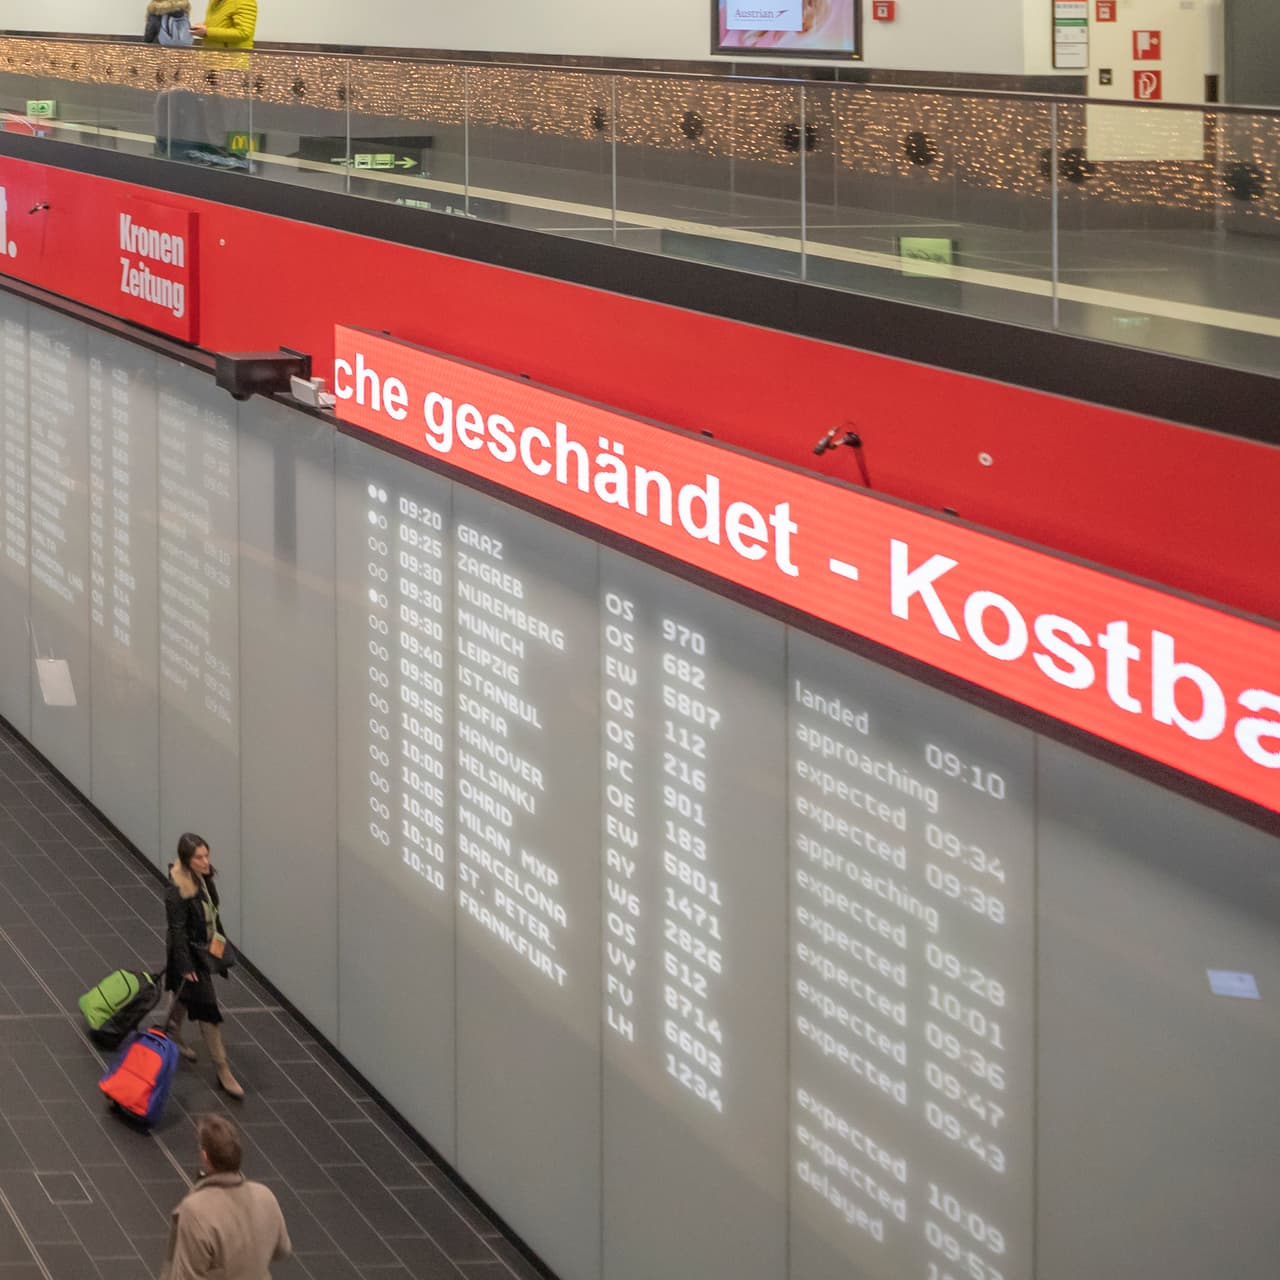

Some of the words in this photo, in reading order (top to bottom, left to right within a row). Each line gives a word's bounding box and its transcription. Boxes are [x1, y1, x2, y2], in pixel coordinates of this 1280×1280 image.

[736, 8, 775, 18] Austrian
[119, 211, 185, 268] Kronen
[120, 255, 186, 319] Zeitung
[334, 353, 408, 422] che
[423, 388, 800, 577] geschändet
[400, 497, 441, 530] 09:20
[458, 524, 502, 559] GRAZ
[606, 593, 633, 621] OS
[663, 619, 705, 655] 970
[796, 680, 868, 734] landed
[400, 524, 441, 558] 09:25
[458, 552, 523, 598] ZAGREB
[606, 625, 634, 653] OS
[663, 653, 705, 690] 682
[796, 723, 938, 813] approaching
[400, 551, 442, 585] 09:30
[459, 581, 564, 650] NUREMBERG
[606, 655, 637, 686] EW
[664, 685, 720, 730] 5807
[796, 760, 906, 831] expected
[400, 578, 442, 613] 09:30
[459, 609, 524, 658] MUNICH
[606, 689, 634, 719] OS
[665, 721, 705, 759] 112
[796, 796, 906, 870] expected
[400, 605, 442, 641] 09:30
[459, 637, 519, 685] LEIPZIG
[606, 720, 634, 751] OS
[664, 753, 706, 792] 216
[796, 834, 938, 933] approaching
[401, 632, 442, 668] 09:40
[459, 665, 542, 729] ISTANBUL
[606, 751, 632, 783] PC
[664, 786, 706, 827] 901
[796, 869, 906, 948] expected
[401, 658, 442, 696] 09:50
[459, 694, 507, 737] SOFIA
[666, 821, 706, 860] 183
[796, 906, 906, 987] expected
[401, 685, 442, 724] 09:55
[459, 722, 544, 791] HANOVER
[607, 814, 638, 848] EW
[664, 851, 721, 905] 5801
[796, 942, 906, 1026] expected
[402, 767, 443, 807] 10:05
[460, 806, 510, 856] MILAN
[522, 850, 558, 886] MXP
[608, 912, 635, 945] OS
[665, 952, 706, 998] 512
[402, 713, 443, 752] 10:00
[459, 750, 535, 814] HELSINKI
[607, 848, 635, 878] AY
[666, 888, 721, 940] 1471
[796, 979, 906, 1065] expected
[403, 740, 443, 779] 10:00
[460, 779, 512, 826] OHRID
[607, 878, 640, 916] W6
[665, 919, 722, 974] 2826
[797, 1016, 906, 1104] expected
[403, 793, 443, 835] 10:05
[460, 834, 567, 927] BARCELONA
[608, 942, 635, 976] VY
[665, 985, 722, 1044] 8714
[796, 1088, 906, 1183] expected
[403, 820, 443, 862] 10:10
[608, 974, 633, 1006] FV
[665, 1020, 722, 1077] 6603
[796, 1124, 906, 1222] expected
[403, 847, 444, 890] 10:10
[460, 890, 567, 986] FRANKFURT
[608, 1006, 633, 1042] LH
[667, 1054, 722, 1112] 1234
[796, 1161, 883, 1242] delayed
